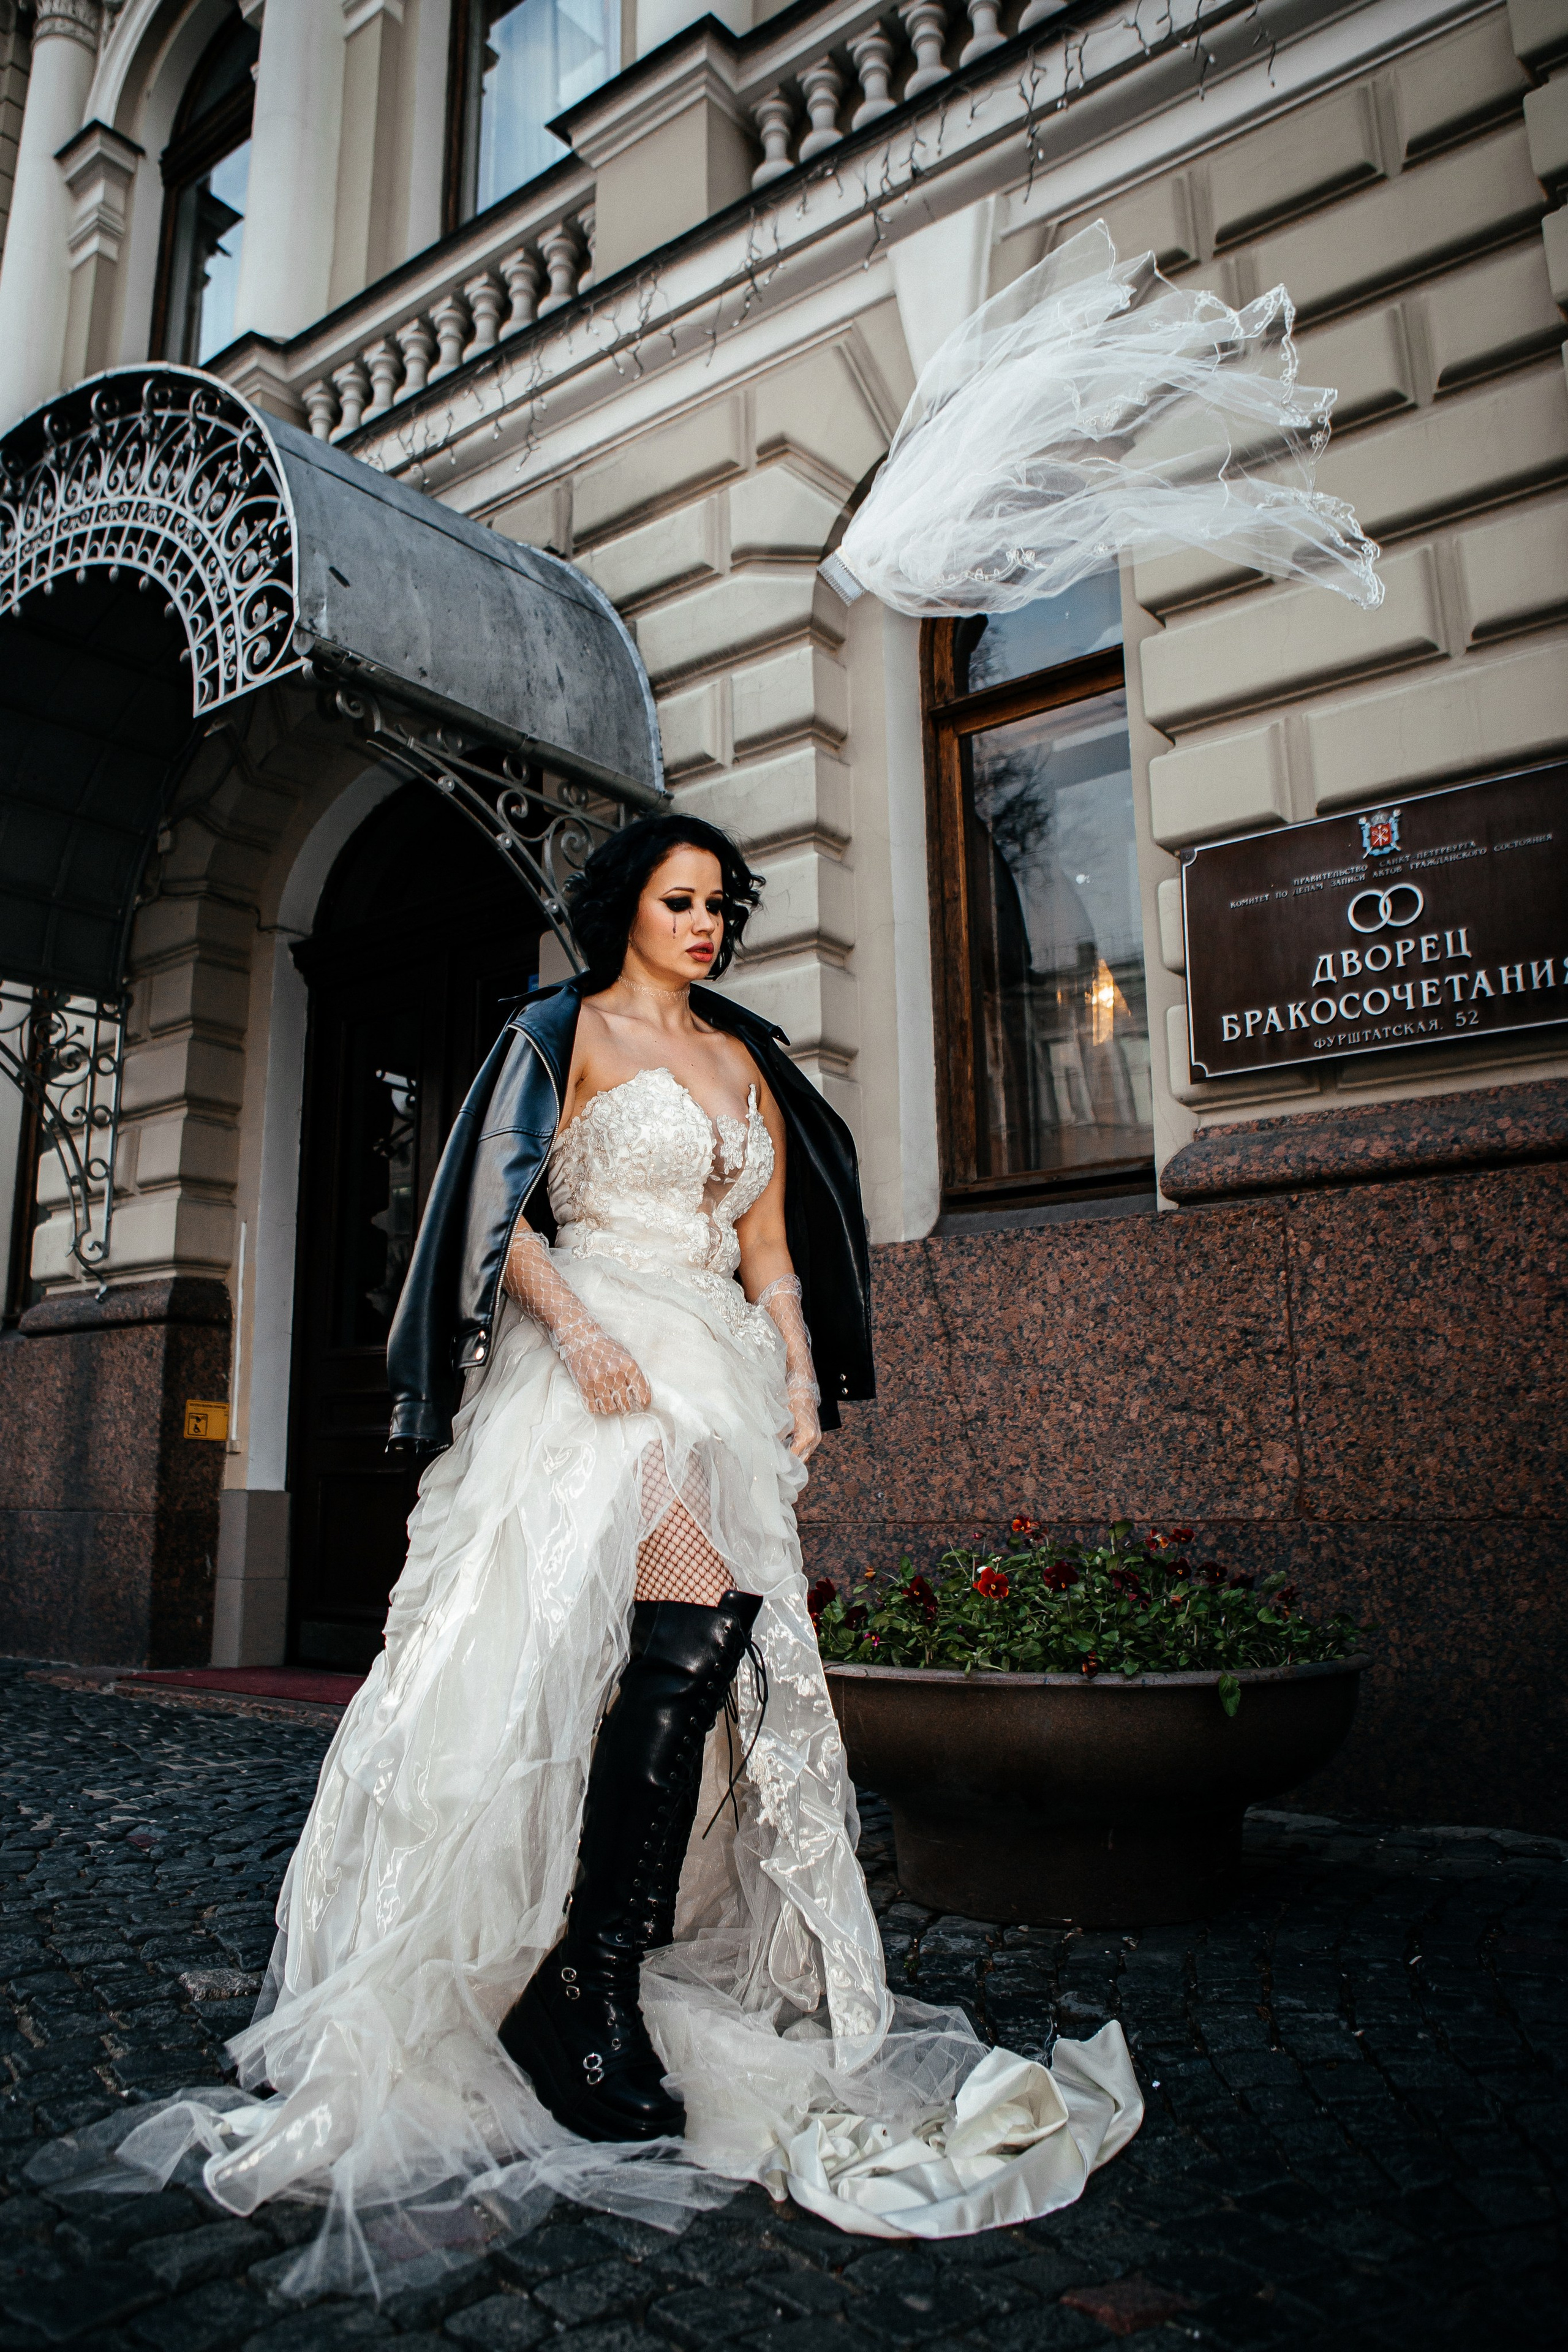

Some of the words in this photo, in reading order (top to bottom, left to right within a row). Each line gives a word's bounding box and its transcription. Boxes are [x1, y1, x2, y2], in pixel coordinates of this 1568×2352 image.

[1230, 894, 1269, 909] КОМИТЕТ
[1275, 891, 1288, 899] ПО
[1292, 882, 1324, 897] ДЕЛАМ
[1330, 873, 1365, 887] ЗАПИСИ
[1373, 865, 1402, 878] АКТОВ
[1409, 846, 1487, 870] ГРАЖДАНСКОГО
[1493, 833, 1553, 852] СОСТОЯНИЯ
[1294, 864, 1368, 886] ПРАВИТЕЛЬСТВО
[1312, 927, 1472, 987] ДВОРЕЦ
[1222, 957, 1568, 1042] БРАКОСОЧЕТАНИ
[1455, 1010, 1480, 1027] 52
